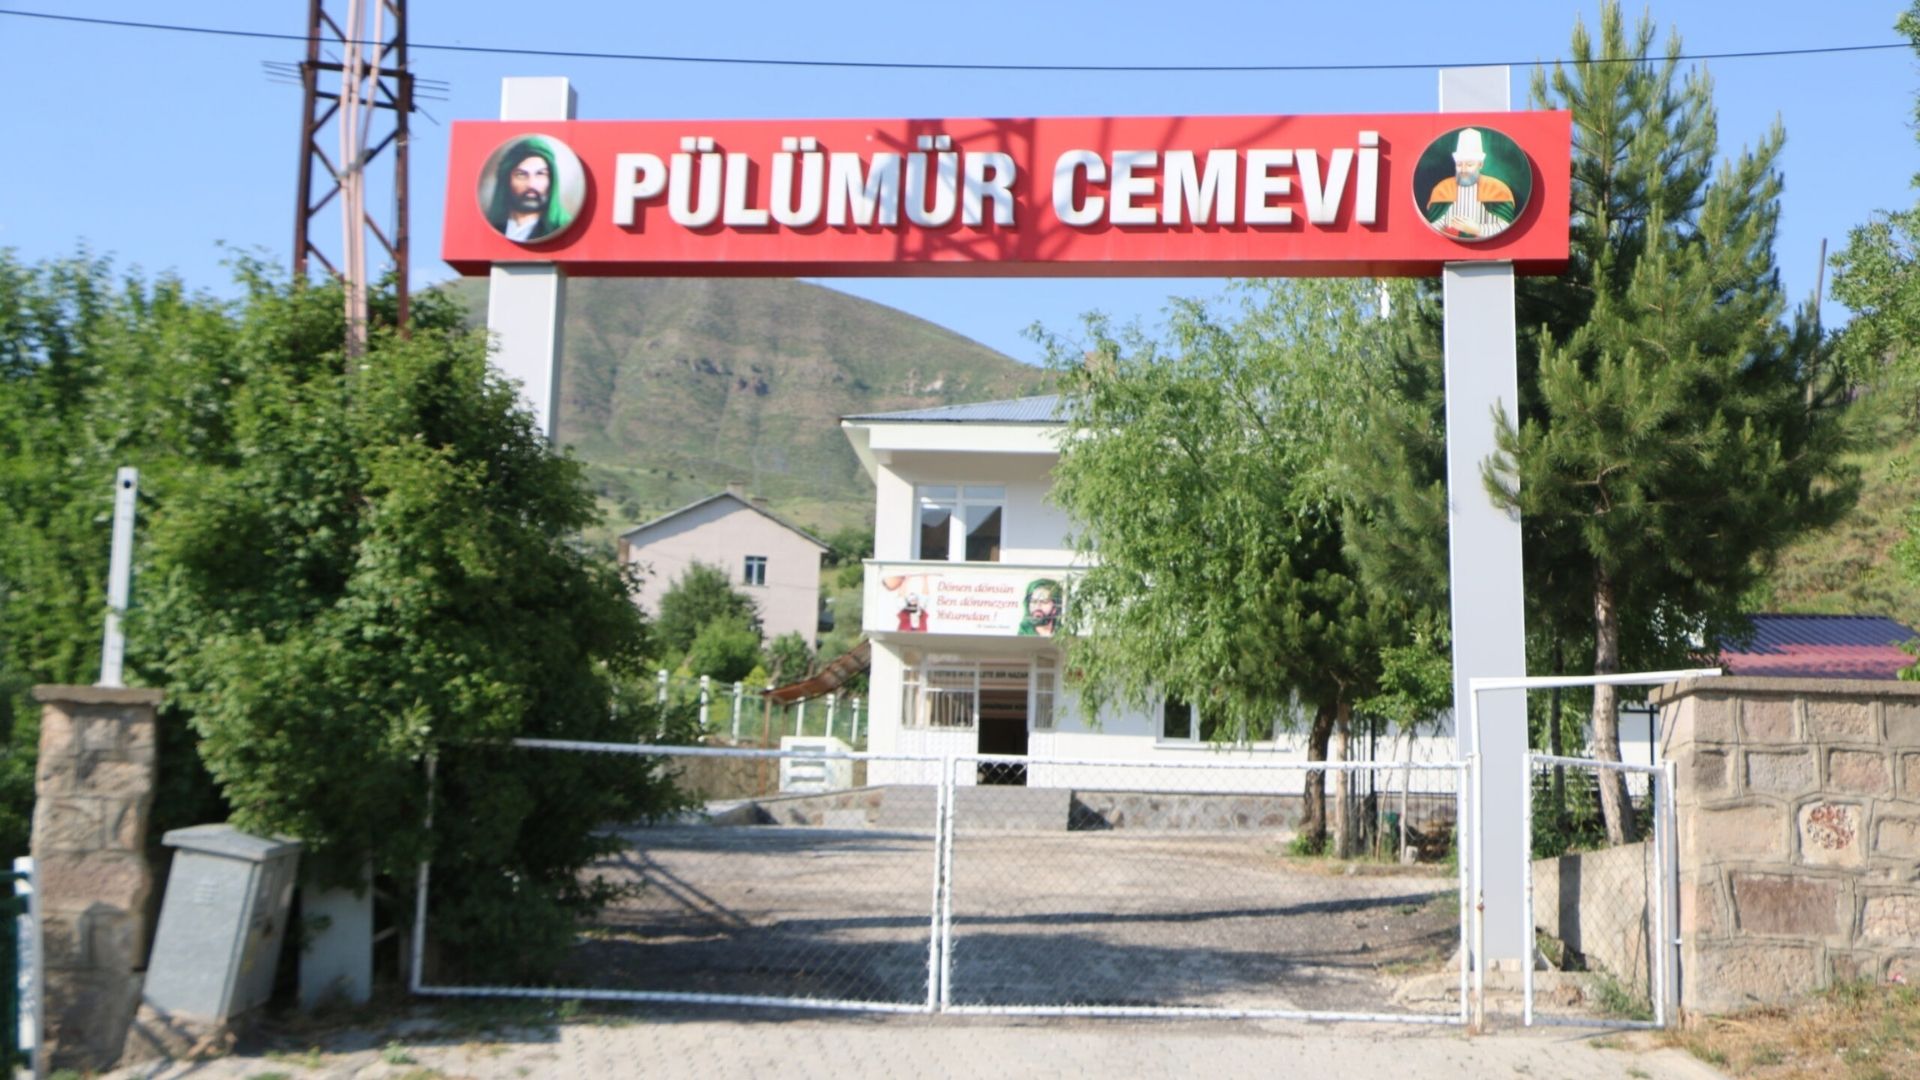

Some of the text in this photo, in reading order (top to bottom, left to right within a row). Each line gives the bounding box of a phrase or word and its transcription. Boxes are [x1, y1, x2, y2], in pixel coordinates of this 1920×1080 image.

[612, 130, 1380, 228] PÜLÜMÜR CEMEVİ
[937, 580, 1015, 594] Dönen dönsün
[936, 595, 957, 606] Ben
